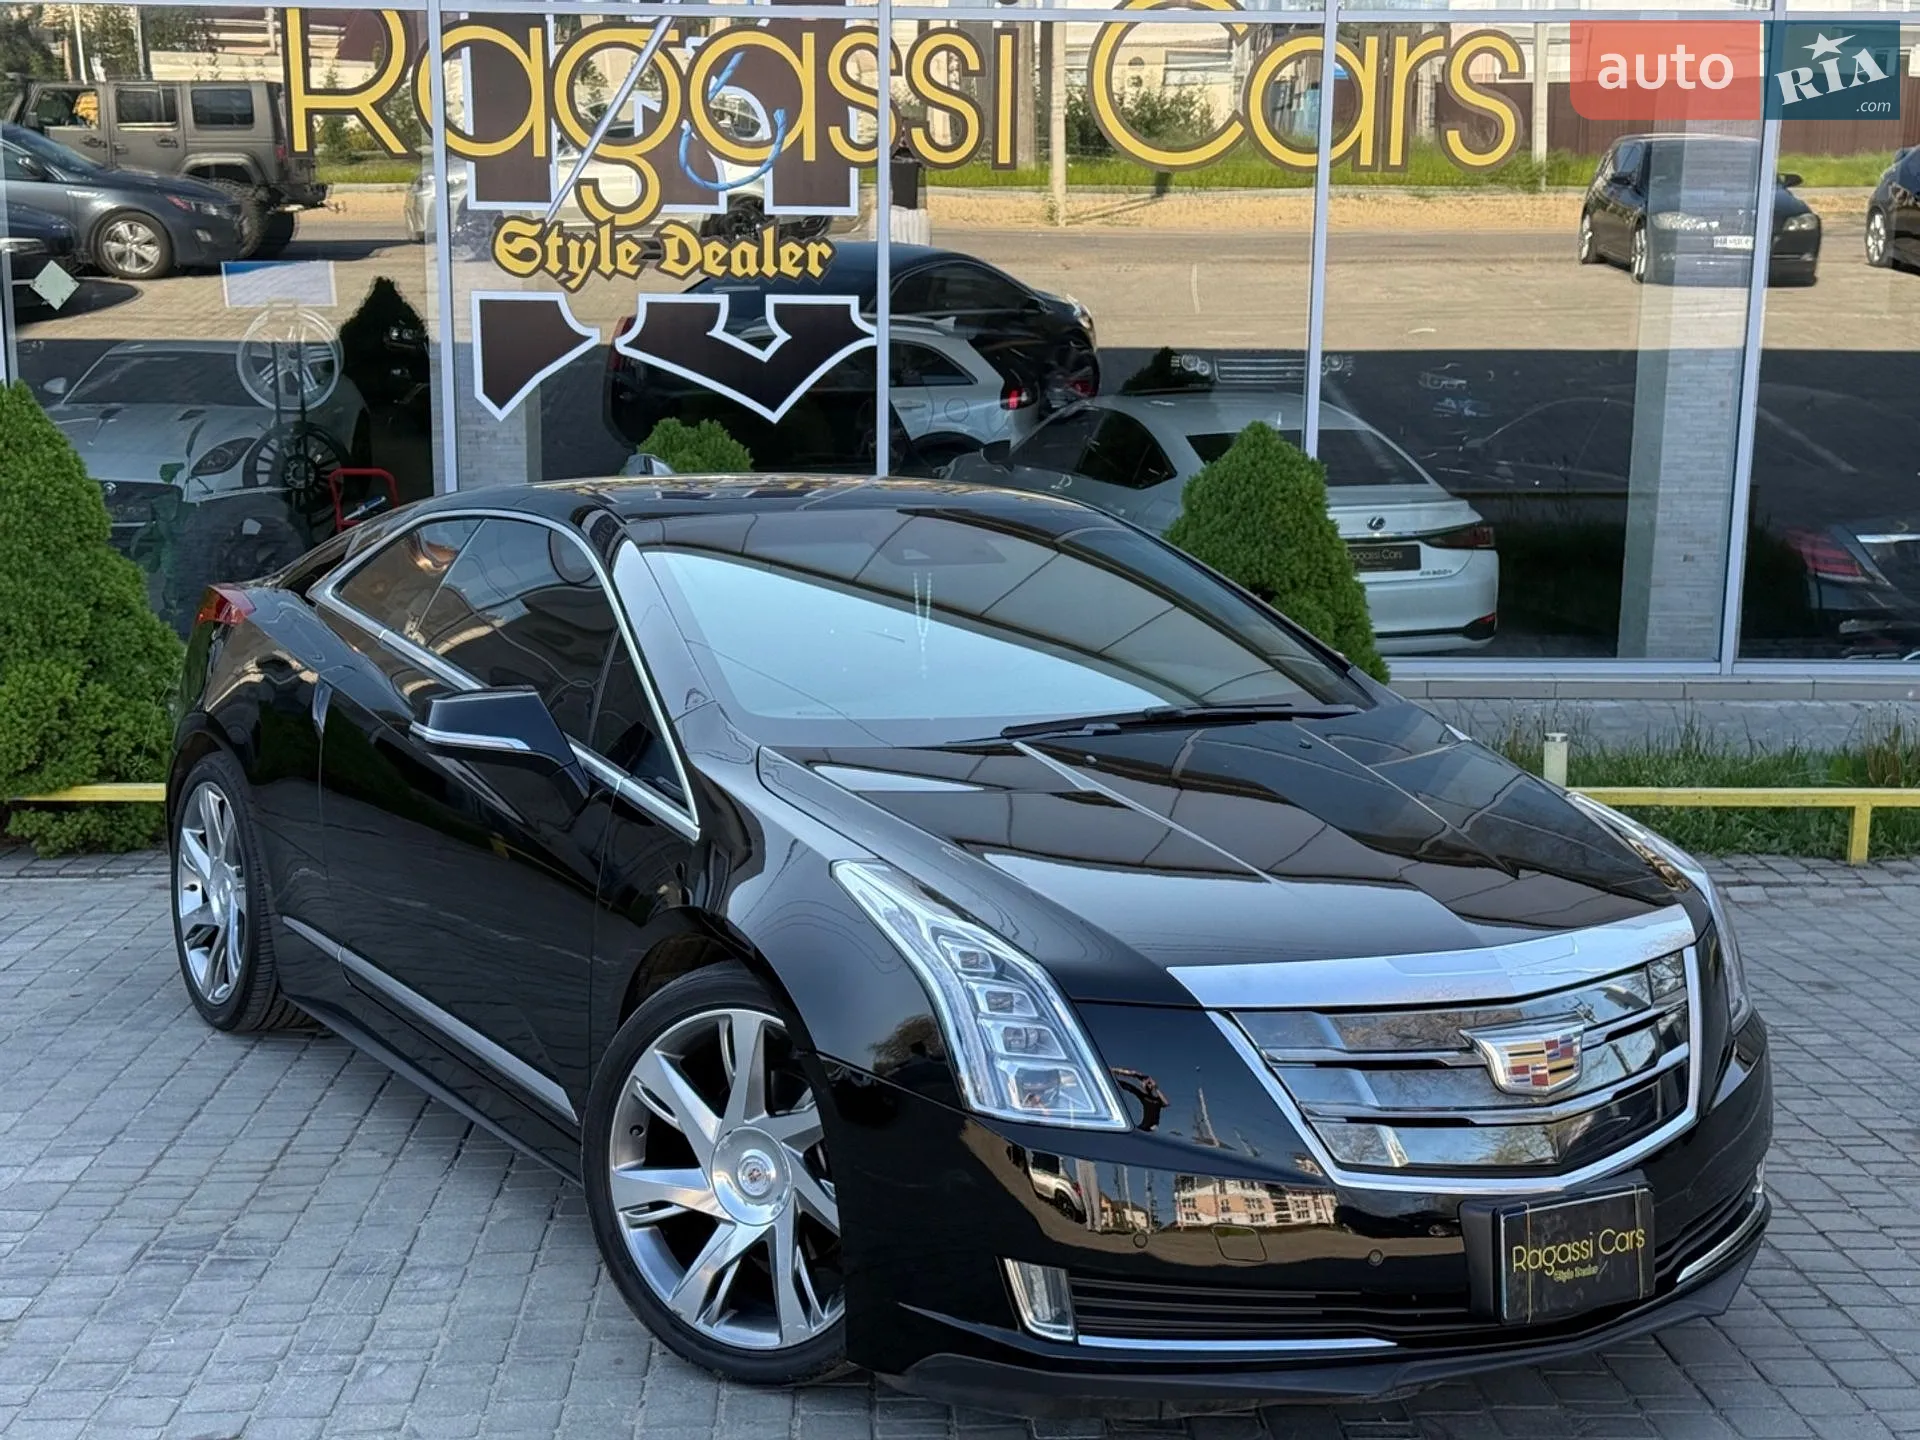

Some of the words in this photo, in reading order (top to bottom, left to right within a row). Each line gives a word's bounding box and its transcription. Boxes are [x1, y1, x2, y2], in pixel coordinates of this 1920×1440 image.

[284, 6, 1018, 228] Ragassi
[1089, 0, 1525, 172] Cars
[491, 215, 650, 291] Style
[653, 218, 837, 284] Dealer
[1511, 1231, 1595, 1277] Ragassi
[1598, 1228, 1646, 1256] Cars
